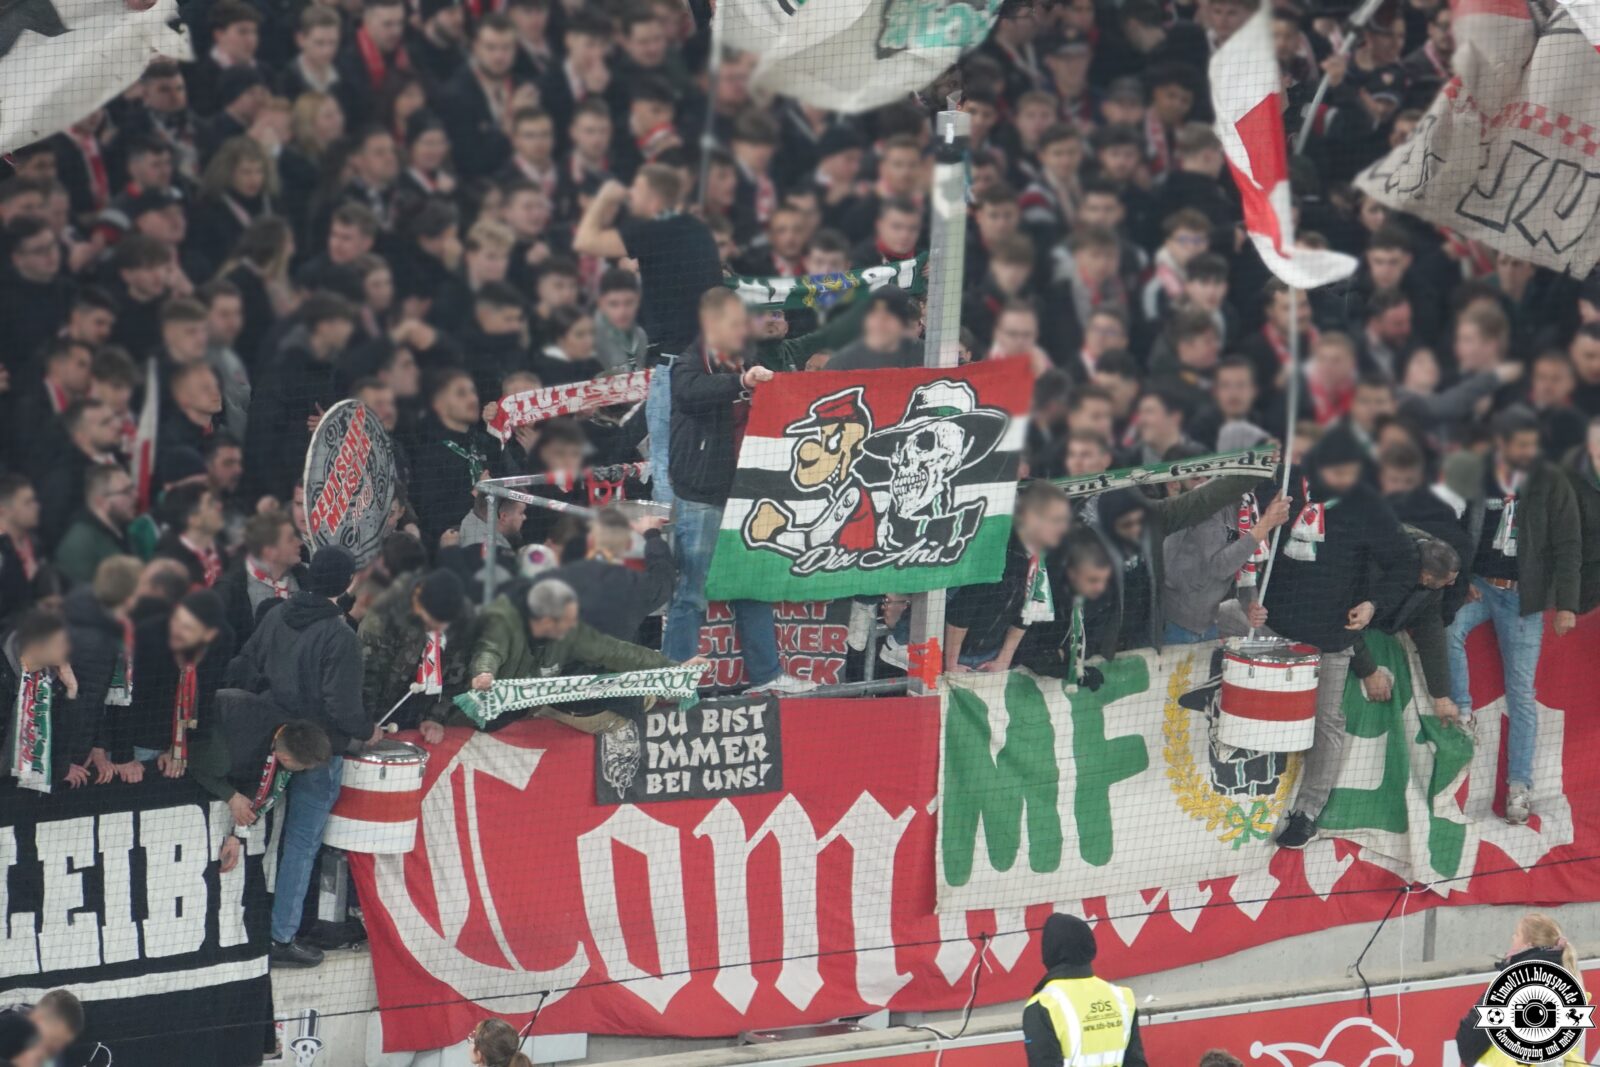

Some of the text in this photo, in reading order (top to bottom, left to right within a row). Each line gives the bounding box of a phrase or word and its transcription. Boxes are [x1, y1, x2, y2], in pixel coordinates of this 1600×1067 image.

[310, 404, 366, 534] DEUTSCHER
[326, 432, 372, 536] MEISTER
[646, 702, 769, 737] DU BIST
[646, 732, 769, 770] IMMER
[646, 763, 772, 794] BEI UNS!
[1091, 1000, 1112, 1013] SDS
